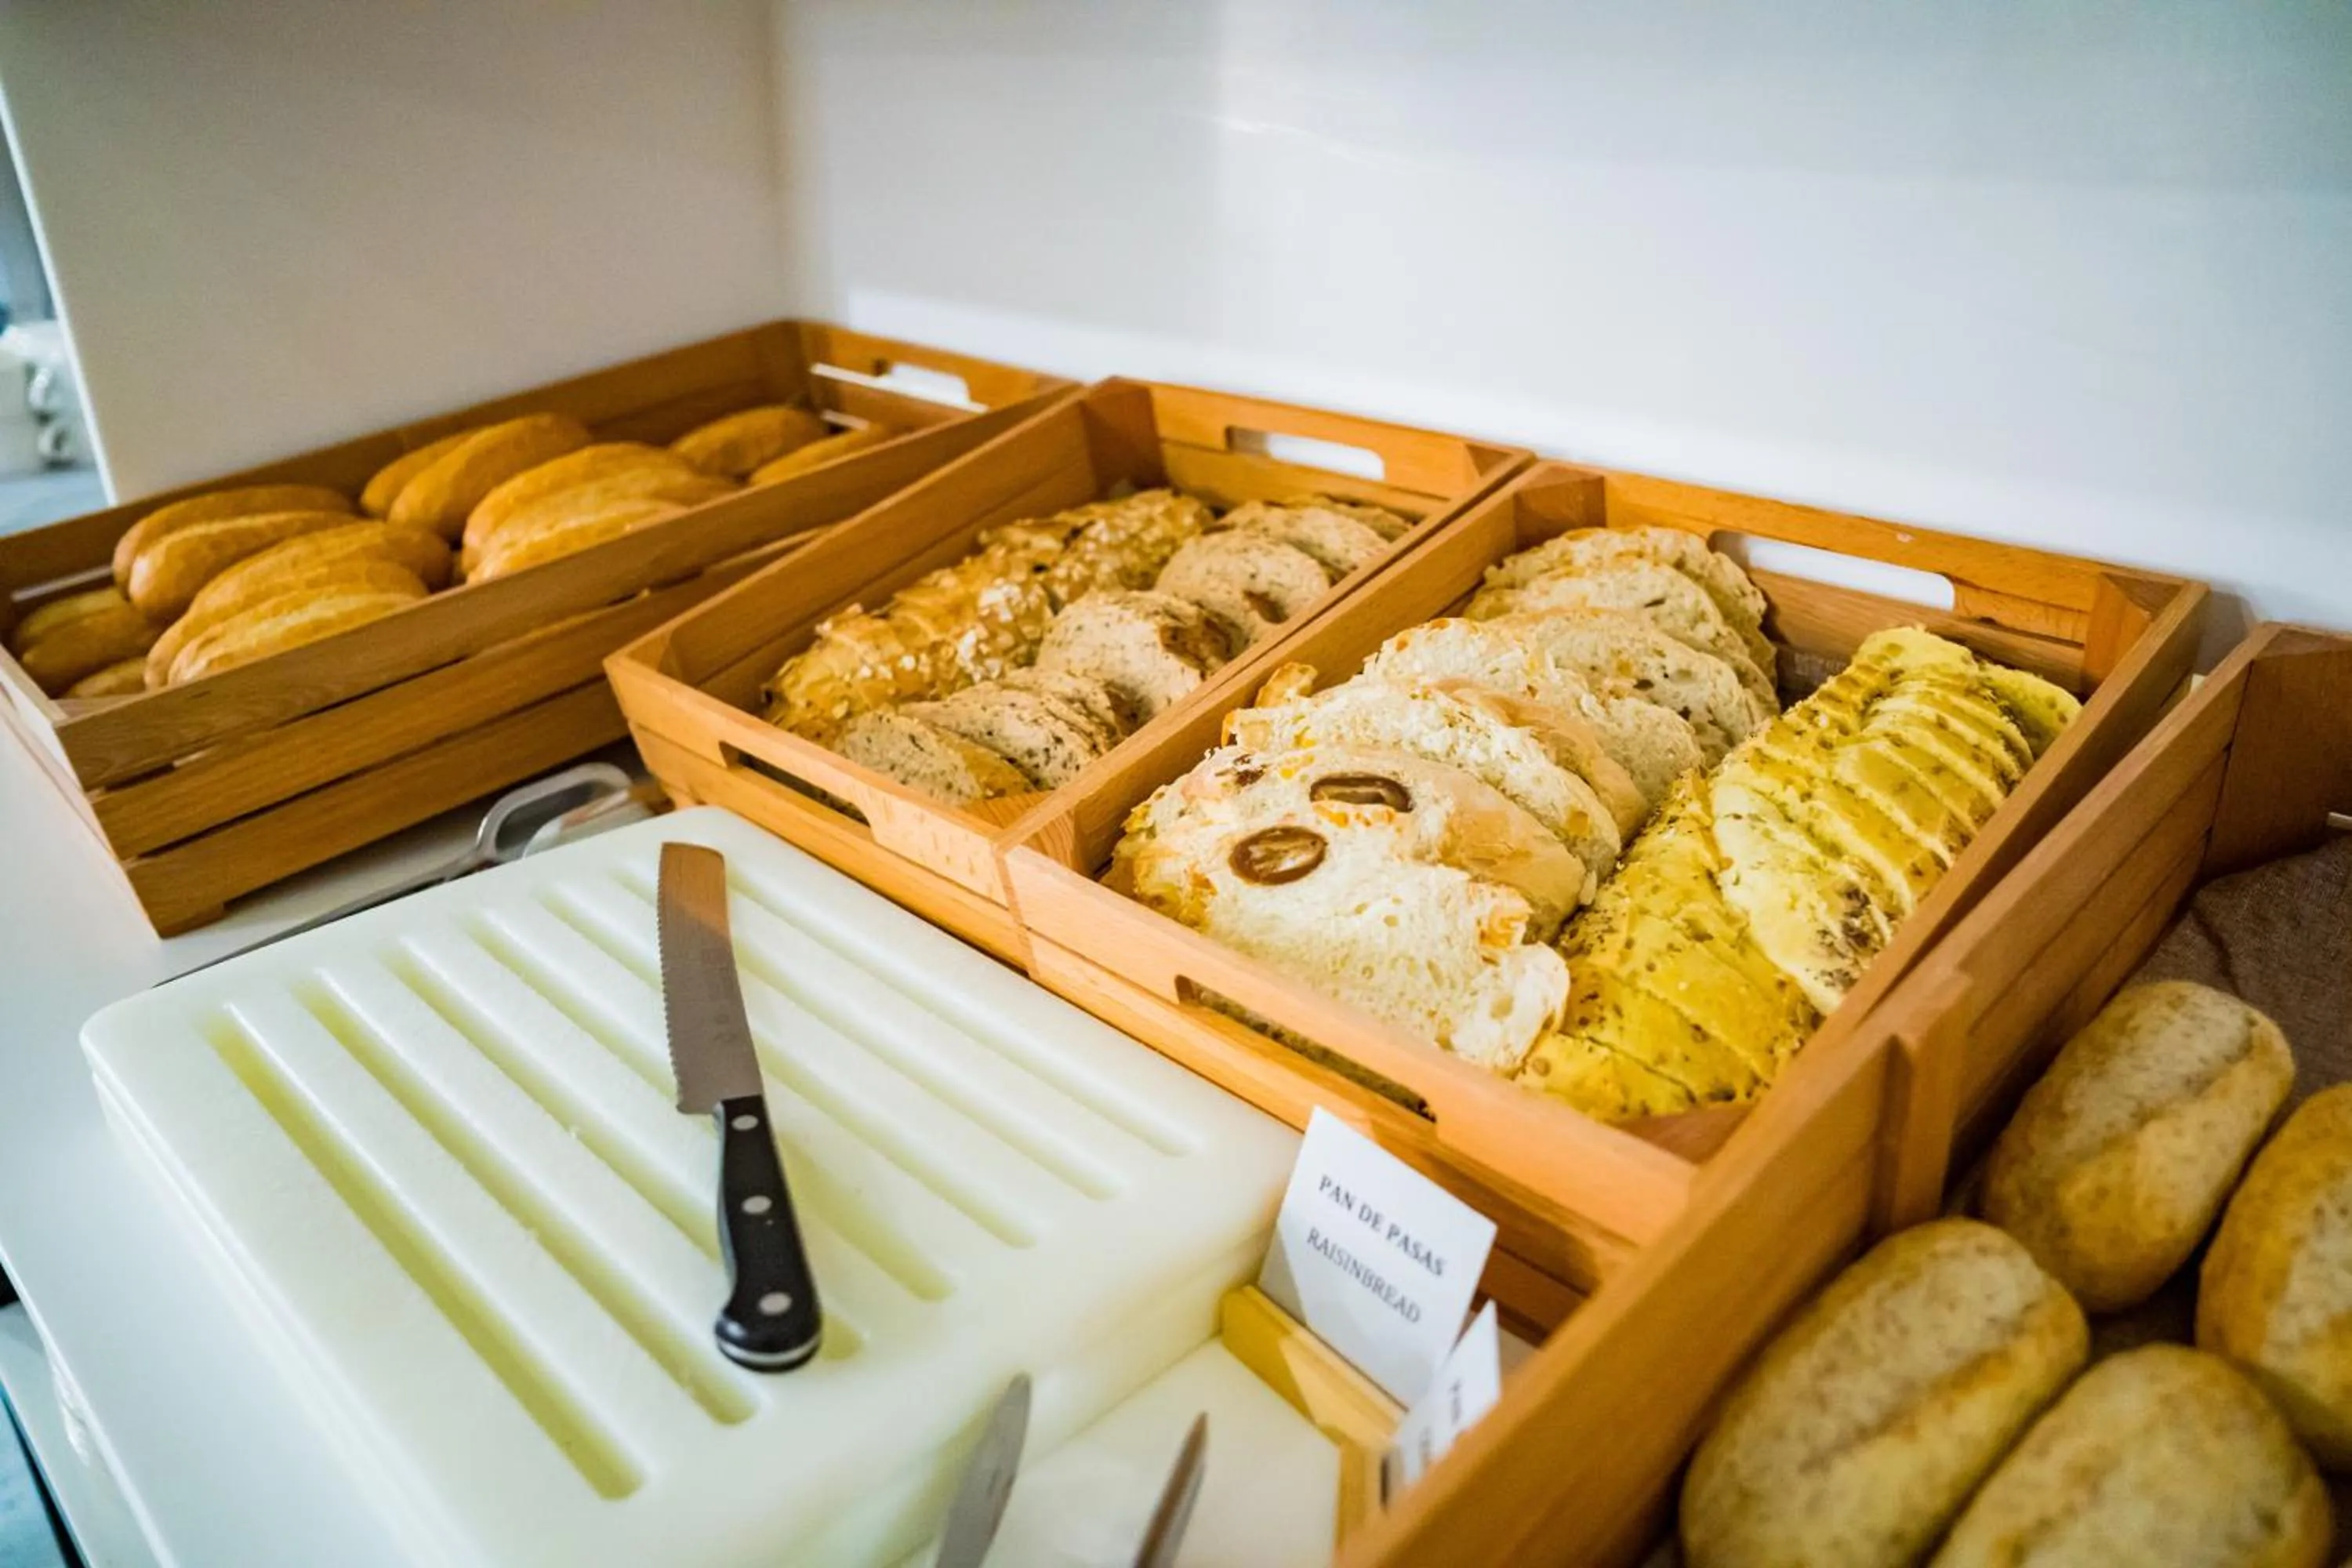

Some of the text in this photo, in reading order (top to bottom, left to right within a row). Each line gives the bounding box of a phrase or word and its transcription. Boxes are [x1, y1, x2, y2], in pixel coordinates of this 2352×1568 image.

[1319, 1174, 1445, 1276] PAN DE PASAS
[1307, 1227, 1421, 1323] RAISINBREAD
